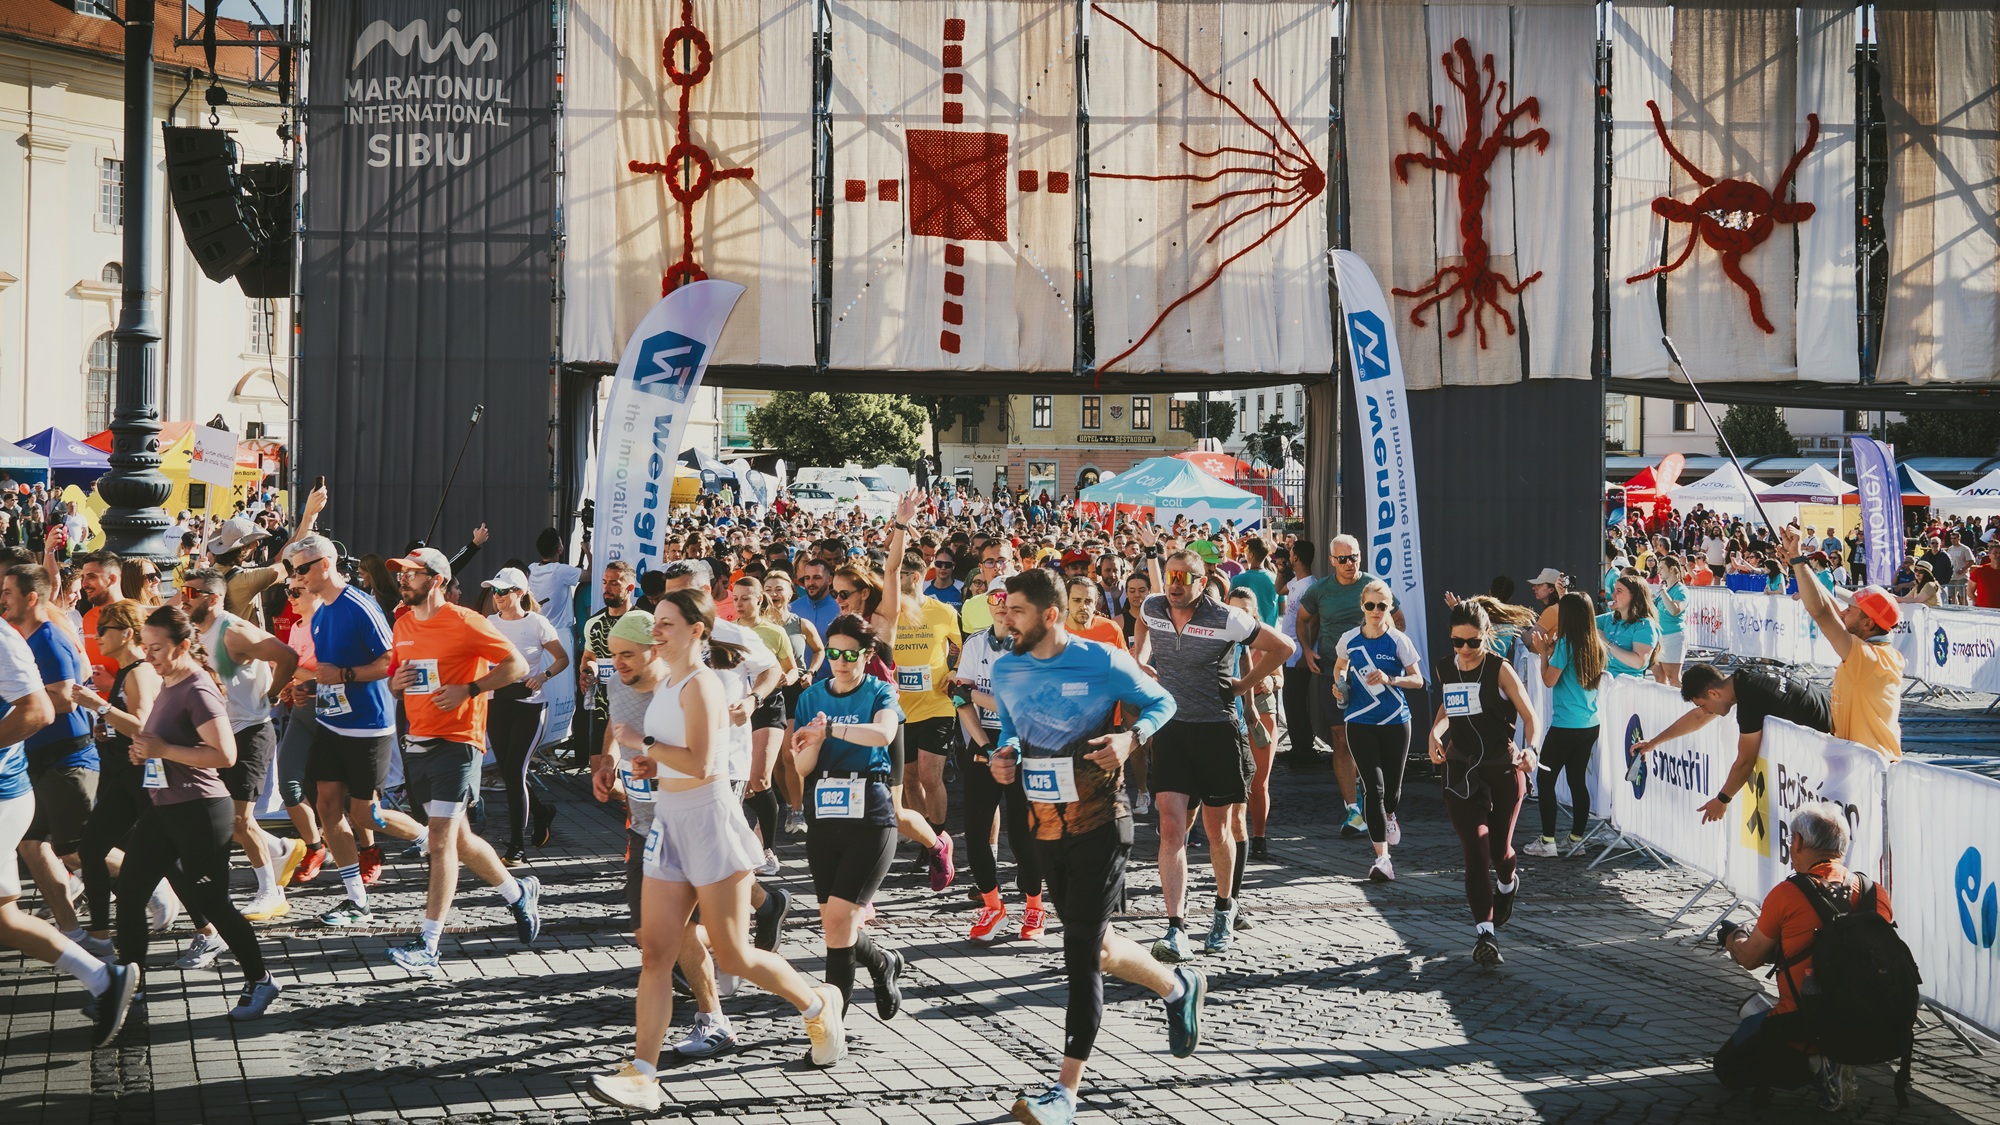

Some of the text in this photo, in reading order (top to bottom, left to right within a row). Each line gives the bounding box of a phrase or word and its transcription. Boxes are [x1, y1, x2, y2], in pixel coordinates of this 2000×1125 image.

[344, 75, 510, 103] MARATONUL
[344, 103, 510, 127] INTERNATIONAL
[367, 132, 471, 168] SIBIU
[623, 402, 641, 433] the
[1079, 435, 1099, 443] HOTEL
[610, 438, 637, 537] innovative
[634, 414, 673, 598] wengl
[1161, 498, 1183, 507] colt
[1150, 619, 1215, 637] SPORT MAITZ
[901, 675, 918, 684] 1772
[820, 790, 844, 805] 1892
